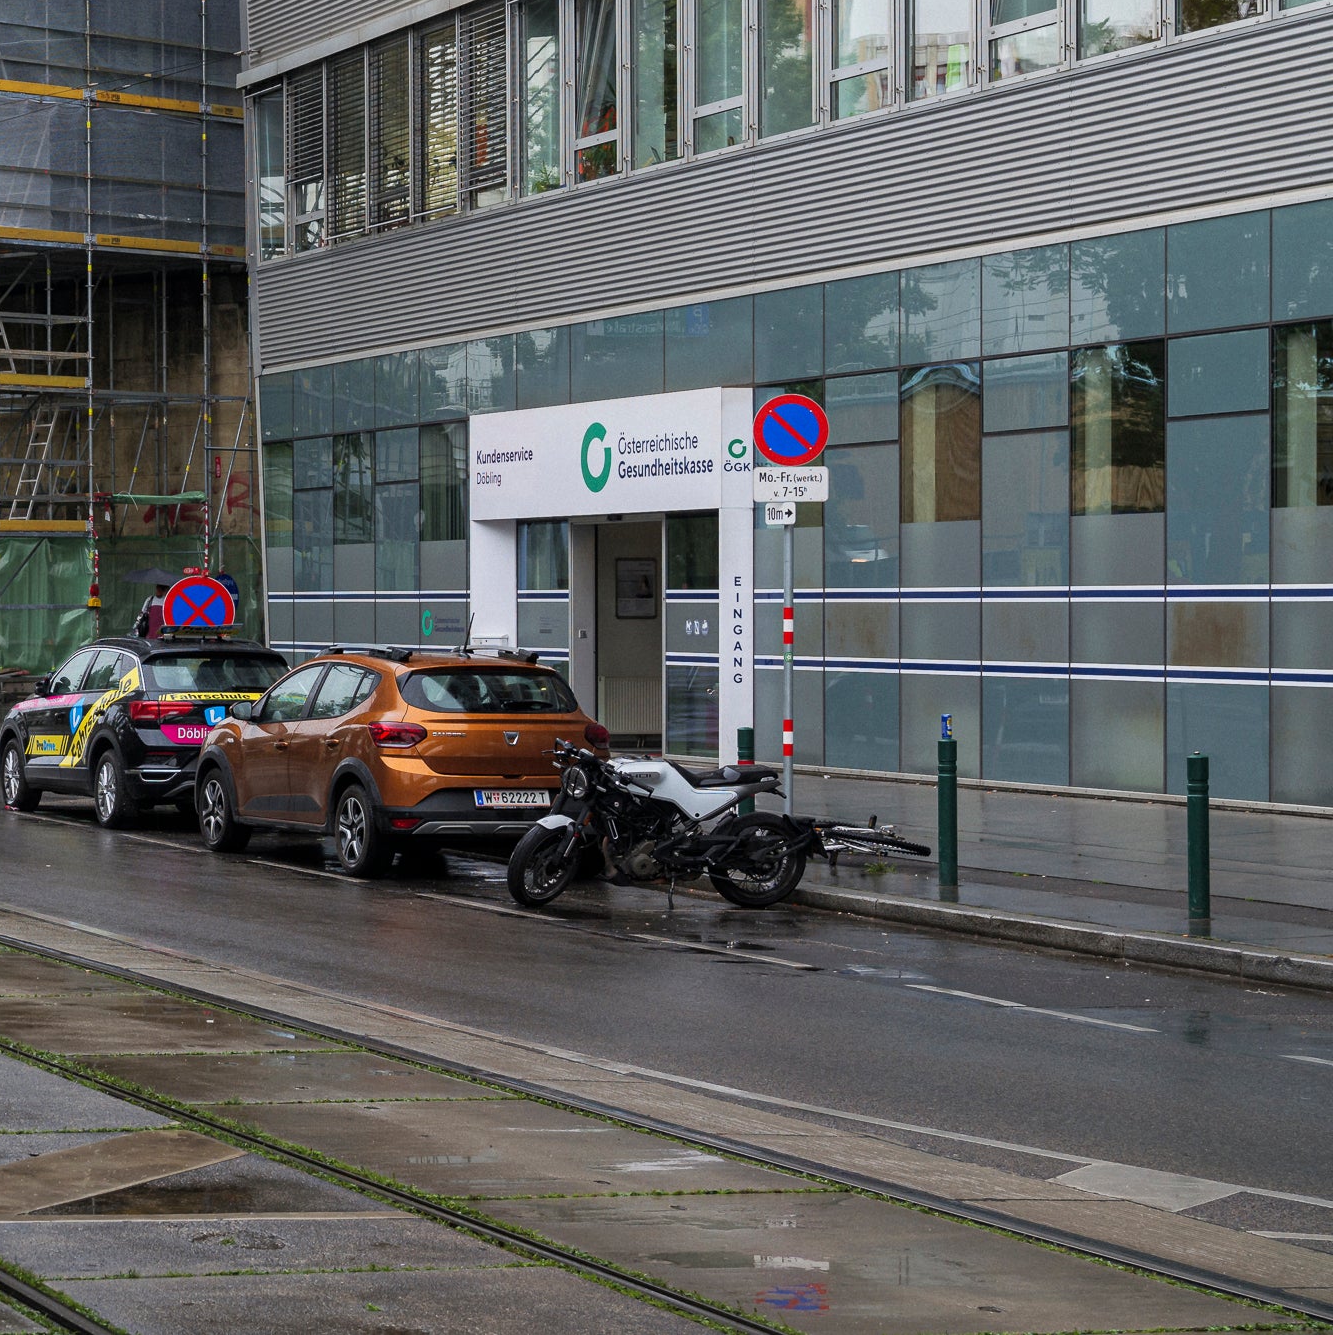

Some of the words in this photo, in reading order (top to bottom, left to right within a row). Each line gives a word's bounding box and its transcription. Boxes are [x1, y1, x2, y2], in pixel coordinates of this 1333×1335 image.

[618, 431, 698, 455] Österreichische
[476, 447, 533, 465] Kundenservice
[618, 457, 714, 479] Gesundheitskasse
[723, 460, 751, 473] ÖGK
[476, 472, 502, 487] Döbling
[759, 472, 793, 483] Mo.-Fr.
[793, 473, 823, 484] (werkt.)
[767, 507, 784, 521] 10m
[733, 576, 743, 684] EINGANG
[170, 693, 251, 701] Fahrschule
[177, 727, 210, 739] Döbli
[484, 792, 493, 803] W
[501, 792, 537, 804] 62222
[539, 793, 546, 804] T
